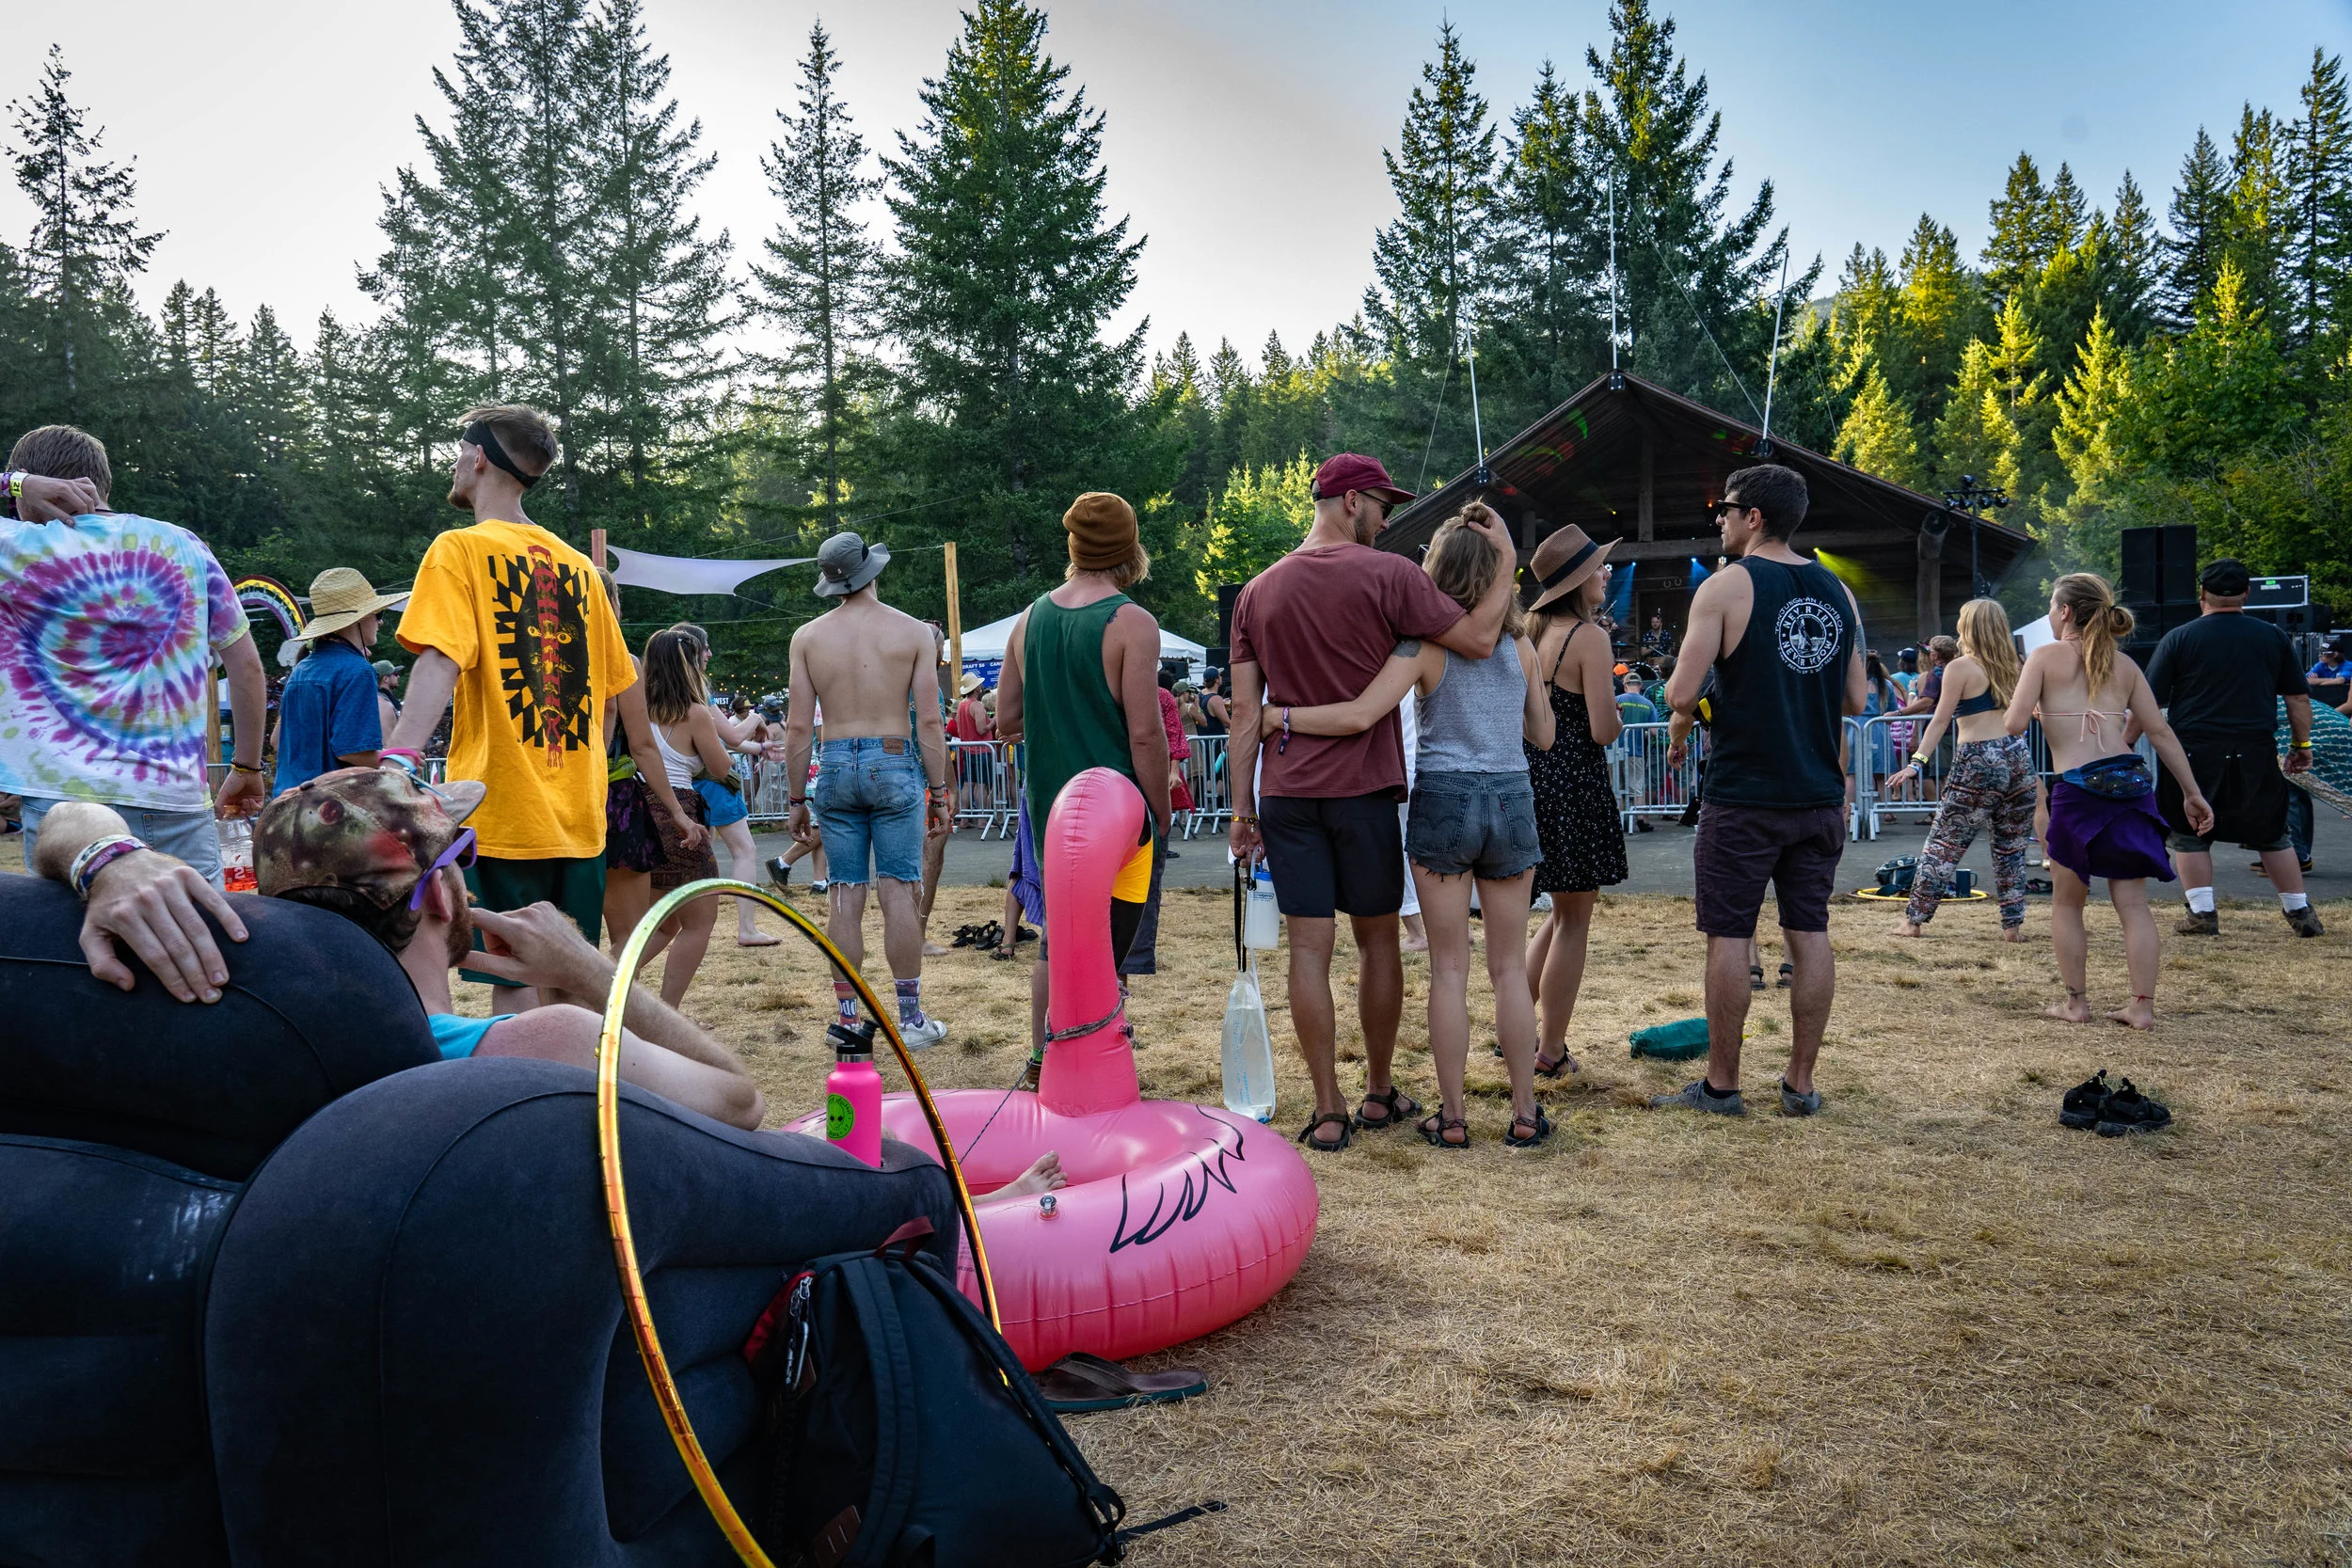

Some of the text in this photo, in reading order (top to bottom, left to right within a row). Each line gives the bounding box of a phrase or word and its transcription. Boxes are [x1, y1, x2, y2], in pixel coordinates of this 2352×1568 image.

[1782, 605, 1835, 629] NEVR TRY
[1819, 600, 1844, 635] LOMBOK
[1782, 640, 1833, 667] NEVER KNOW
[234, 866, 246, 879] 2
